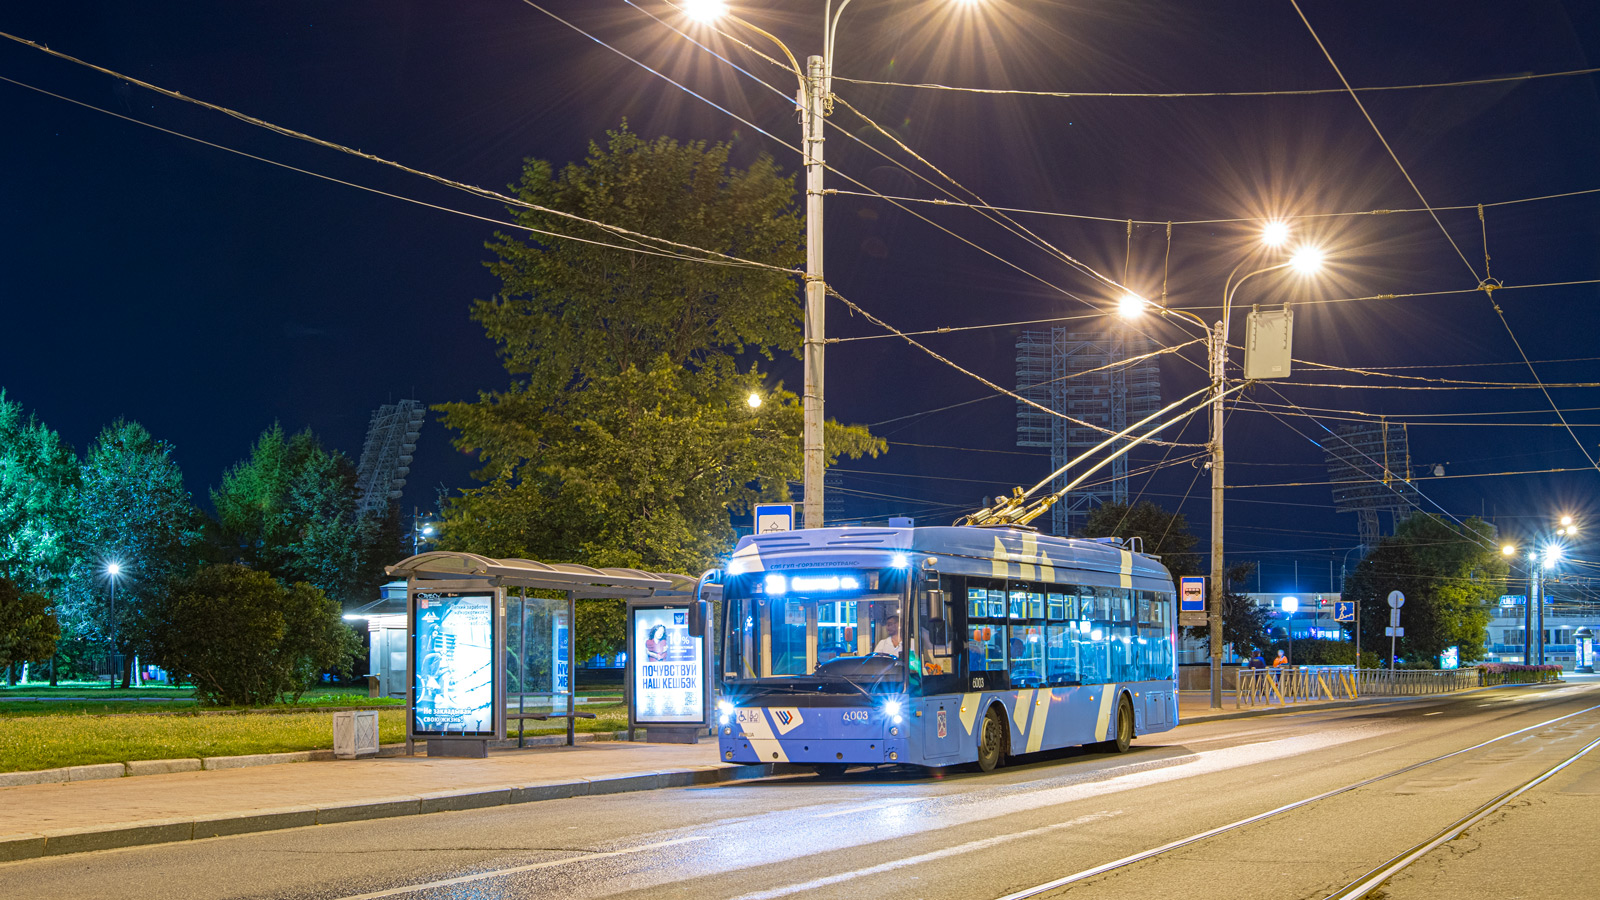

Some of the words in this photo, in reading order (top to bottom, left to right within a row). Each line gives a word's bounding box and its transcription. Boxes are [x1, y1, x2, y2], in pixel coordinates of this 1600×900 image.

[642, 662, 697, 677] ПОЧУВСТВУЙ
[642, 677, 661, 689] НАШ
[662, 677, 697, 689] КЕШБЭК
[972, 677, 985, 688] 6003
[843, 710, 869, 721] 6003
